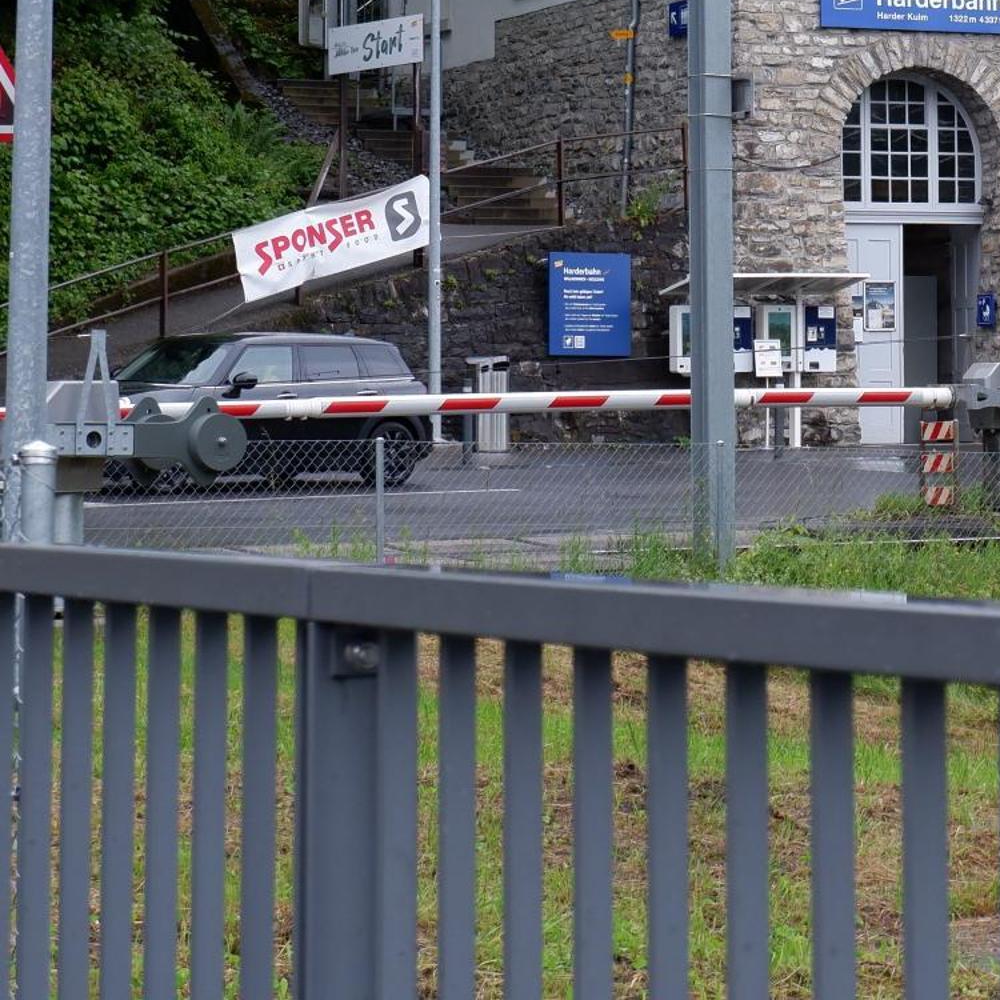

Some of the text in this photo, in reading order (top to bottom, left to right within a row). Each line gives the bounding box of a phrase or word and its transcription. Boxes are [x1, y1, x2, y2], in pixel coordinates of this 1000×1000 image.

[877, 12, 928, 20] Harder Kulm
[362, 23, 406, 62] Start
[254, 209, 376, 276] SPONSER
